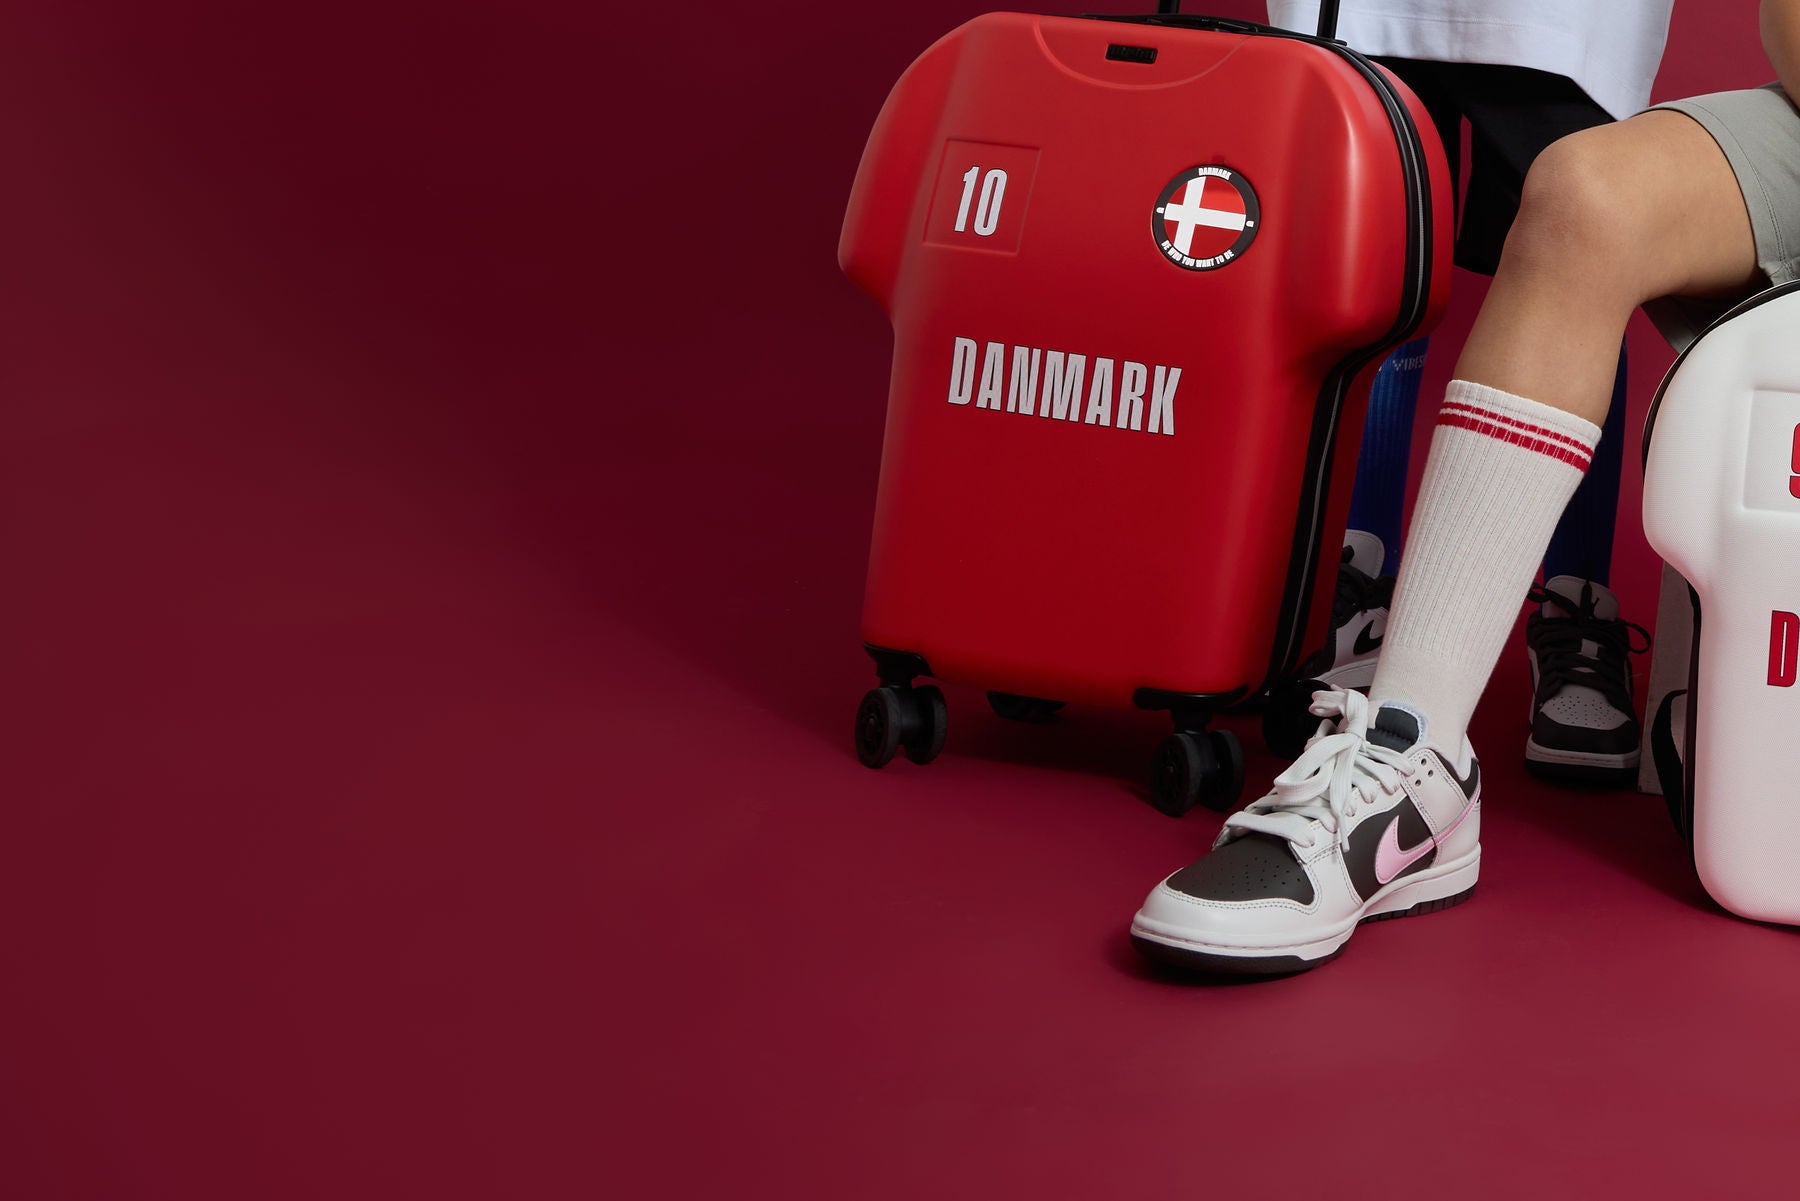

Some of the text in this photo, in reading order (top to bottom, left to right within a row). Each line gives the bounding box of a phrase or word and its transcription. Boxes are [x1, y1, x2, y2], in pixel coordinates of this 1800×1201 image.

[1198, 167, 1232, 180] DANMARK
[953, 165, 1009, 238] 10
[1182, 256, 1195, 267] YOU
[1196, 258, 1214, 268] WANT
[1215, 254, 1224, 264] TO
[1224, 249, 1234, 260] BE
[946, 335, 1183, 437] DANMARK
